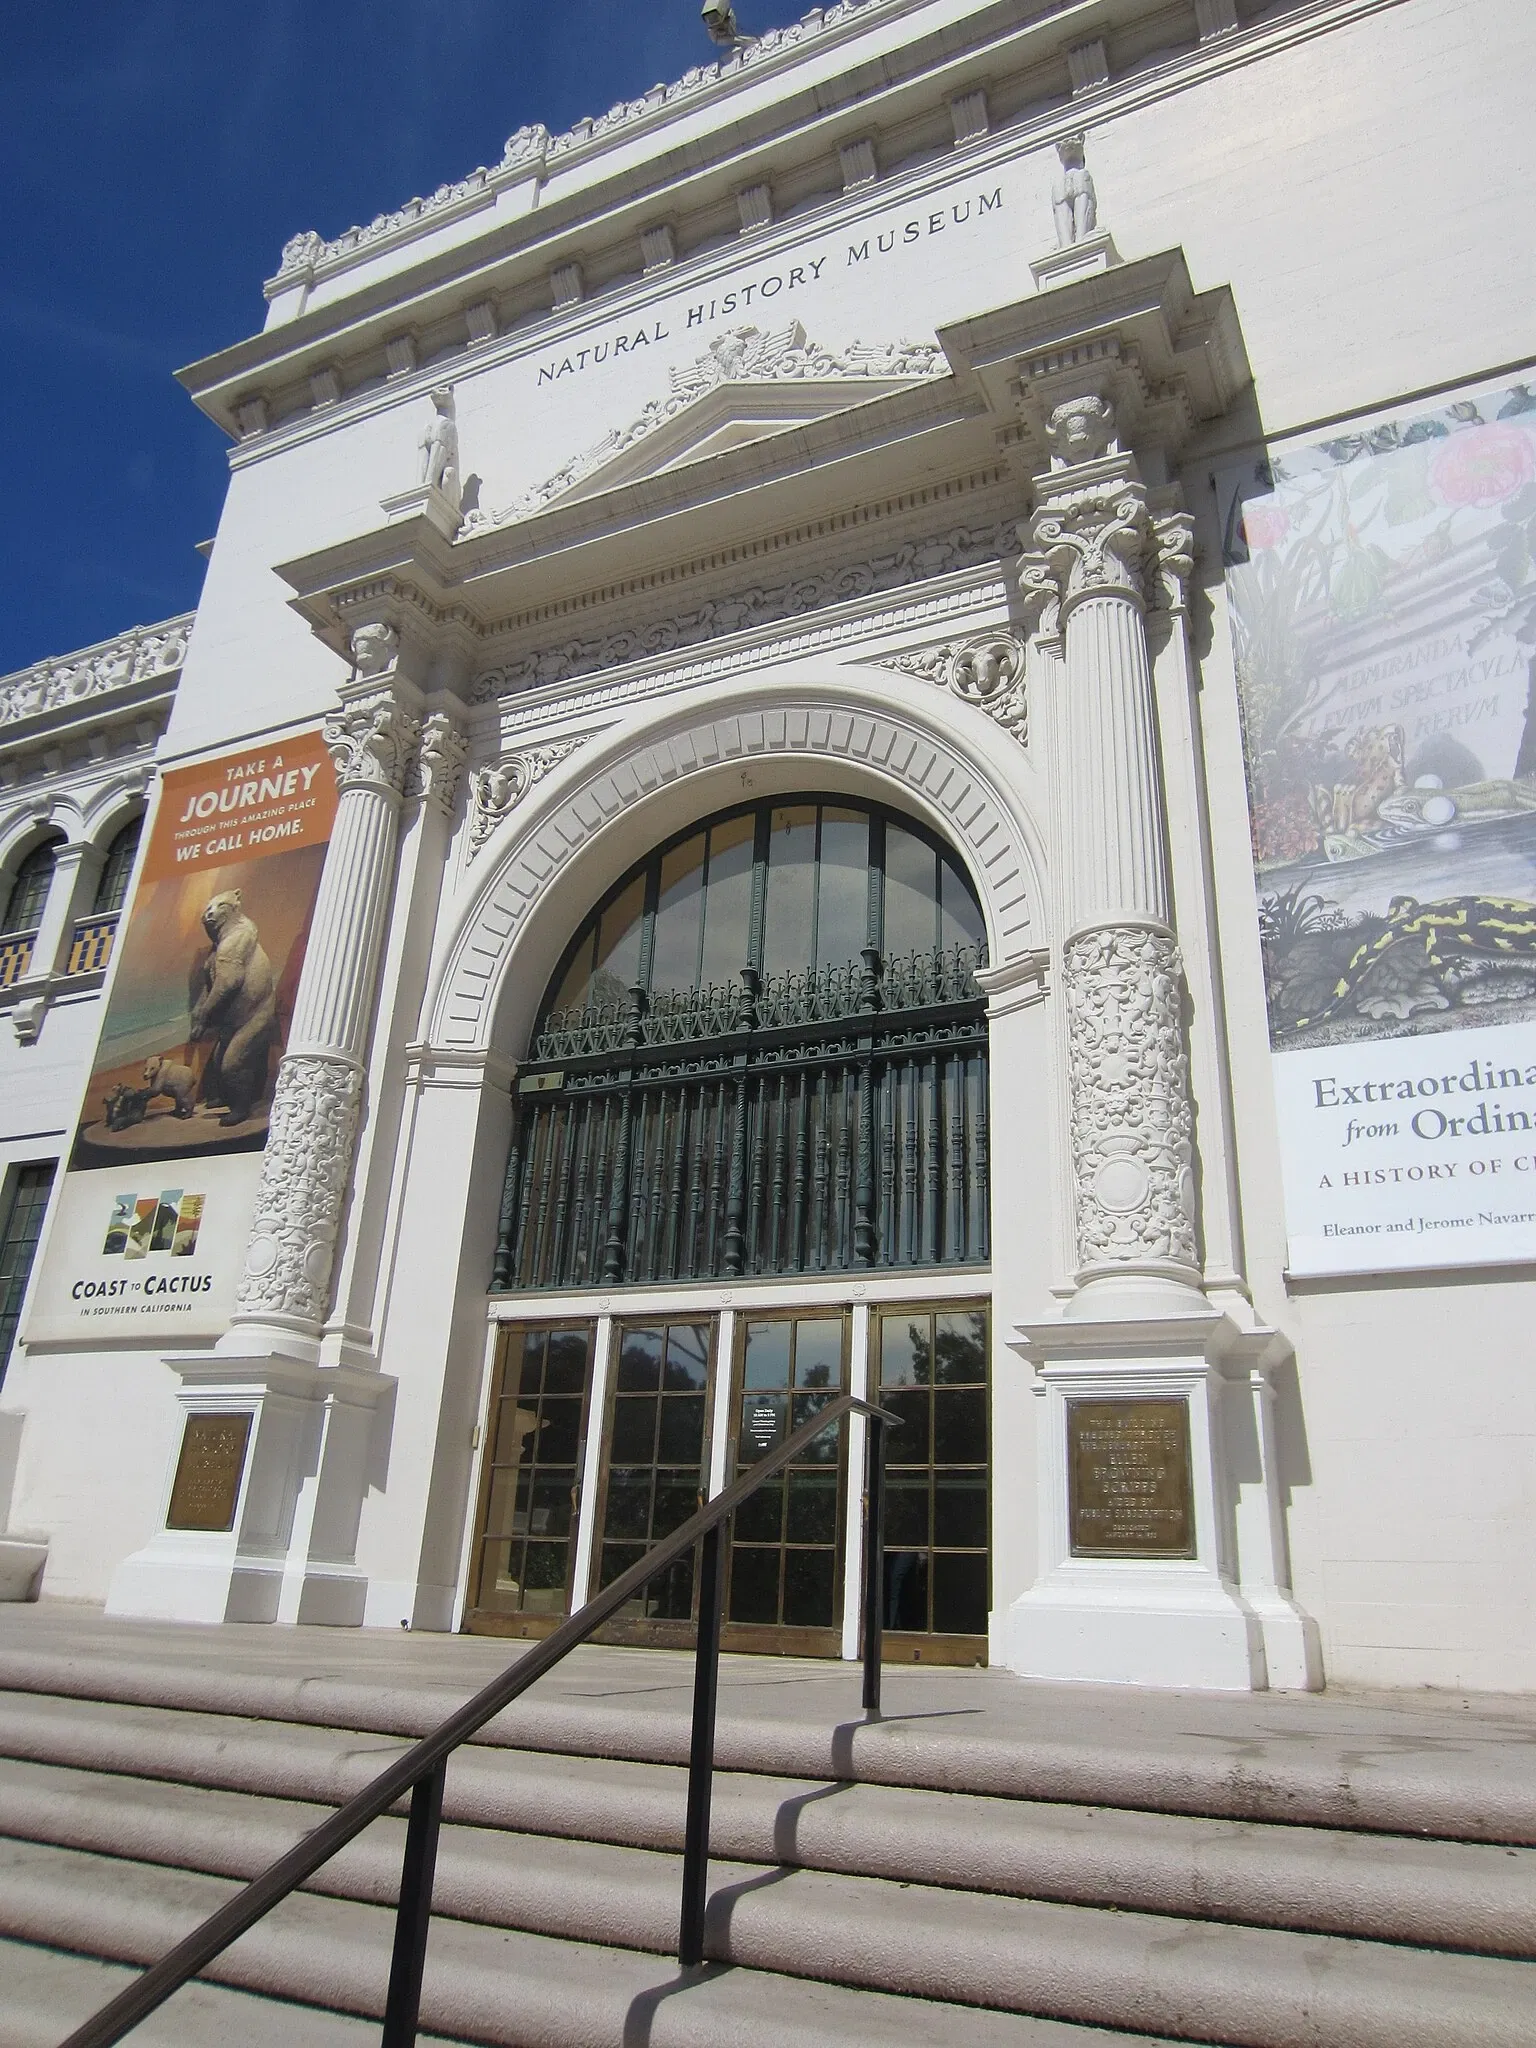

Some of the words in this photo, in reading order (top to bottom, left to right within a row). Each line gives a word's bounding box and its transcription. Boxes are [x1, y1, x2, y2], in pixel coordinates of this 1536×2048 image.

[537, 320, 669, 387] NATURAL
[686, 256, 827, 328] HISTORY
[847, 187, 1005, 266] MUSEUM
[227, 759, 266, 782] TAKE
[273, 755, 284, 769] A
[180, 762, 322, 823] JOURNEY
[174, 823, 217, 840] THROUGH
[219, 818, 239, 831] THIS
[240, 806, 286, 824] AMAZING
[288, 797, 318, 812] PLACE
[176, 844, 202, 862] WE
[205, 835, 244, 856] CALL
[249, 818, 305, 846] HOME.
[1342, 1118, 1400, 1147] from
[1411, 1102, 1536, 1140] Ordin
[1318, 1175, 1333, 1189] A
[1343, 1163, 1459, 1187] HISTORY
[1468, 1159, 1503, 1176] OF
[1323, 1224, 1382, 1237] Eleanor
[1386, 1218, 1414, 1233] and
[1417, 1217, 1475, 1234] Jerome
[72, 1279, 128, 1300] COAST
[130, 1282, 141, 1291] TO
[143, 1275, 213, 1295] CACTUS
[92, 1306, 138, 1316] SOUTHERN
[140, 1303, 192, 1313] CALIFORNIA
[1093, 1467, 1166, 1480] BROWNING
[1102, 1481, 1157, 1493] SCRIPPS
